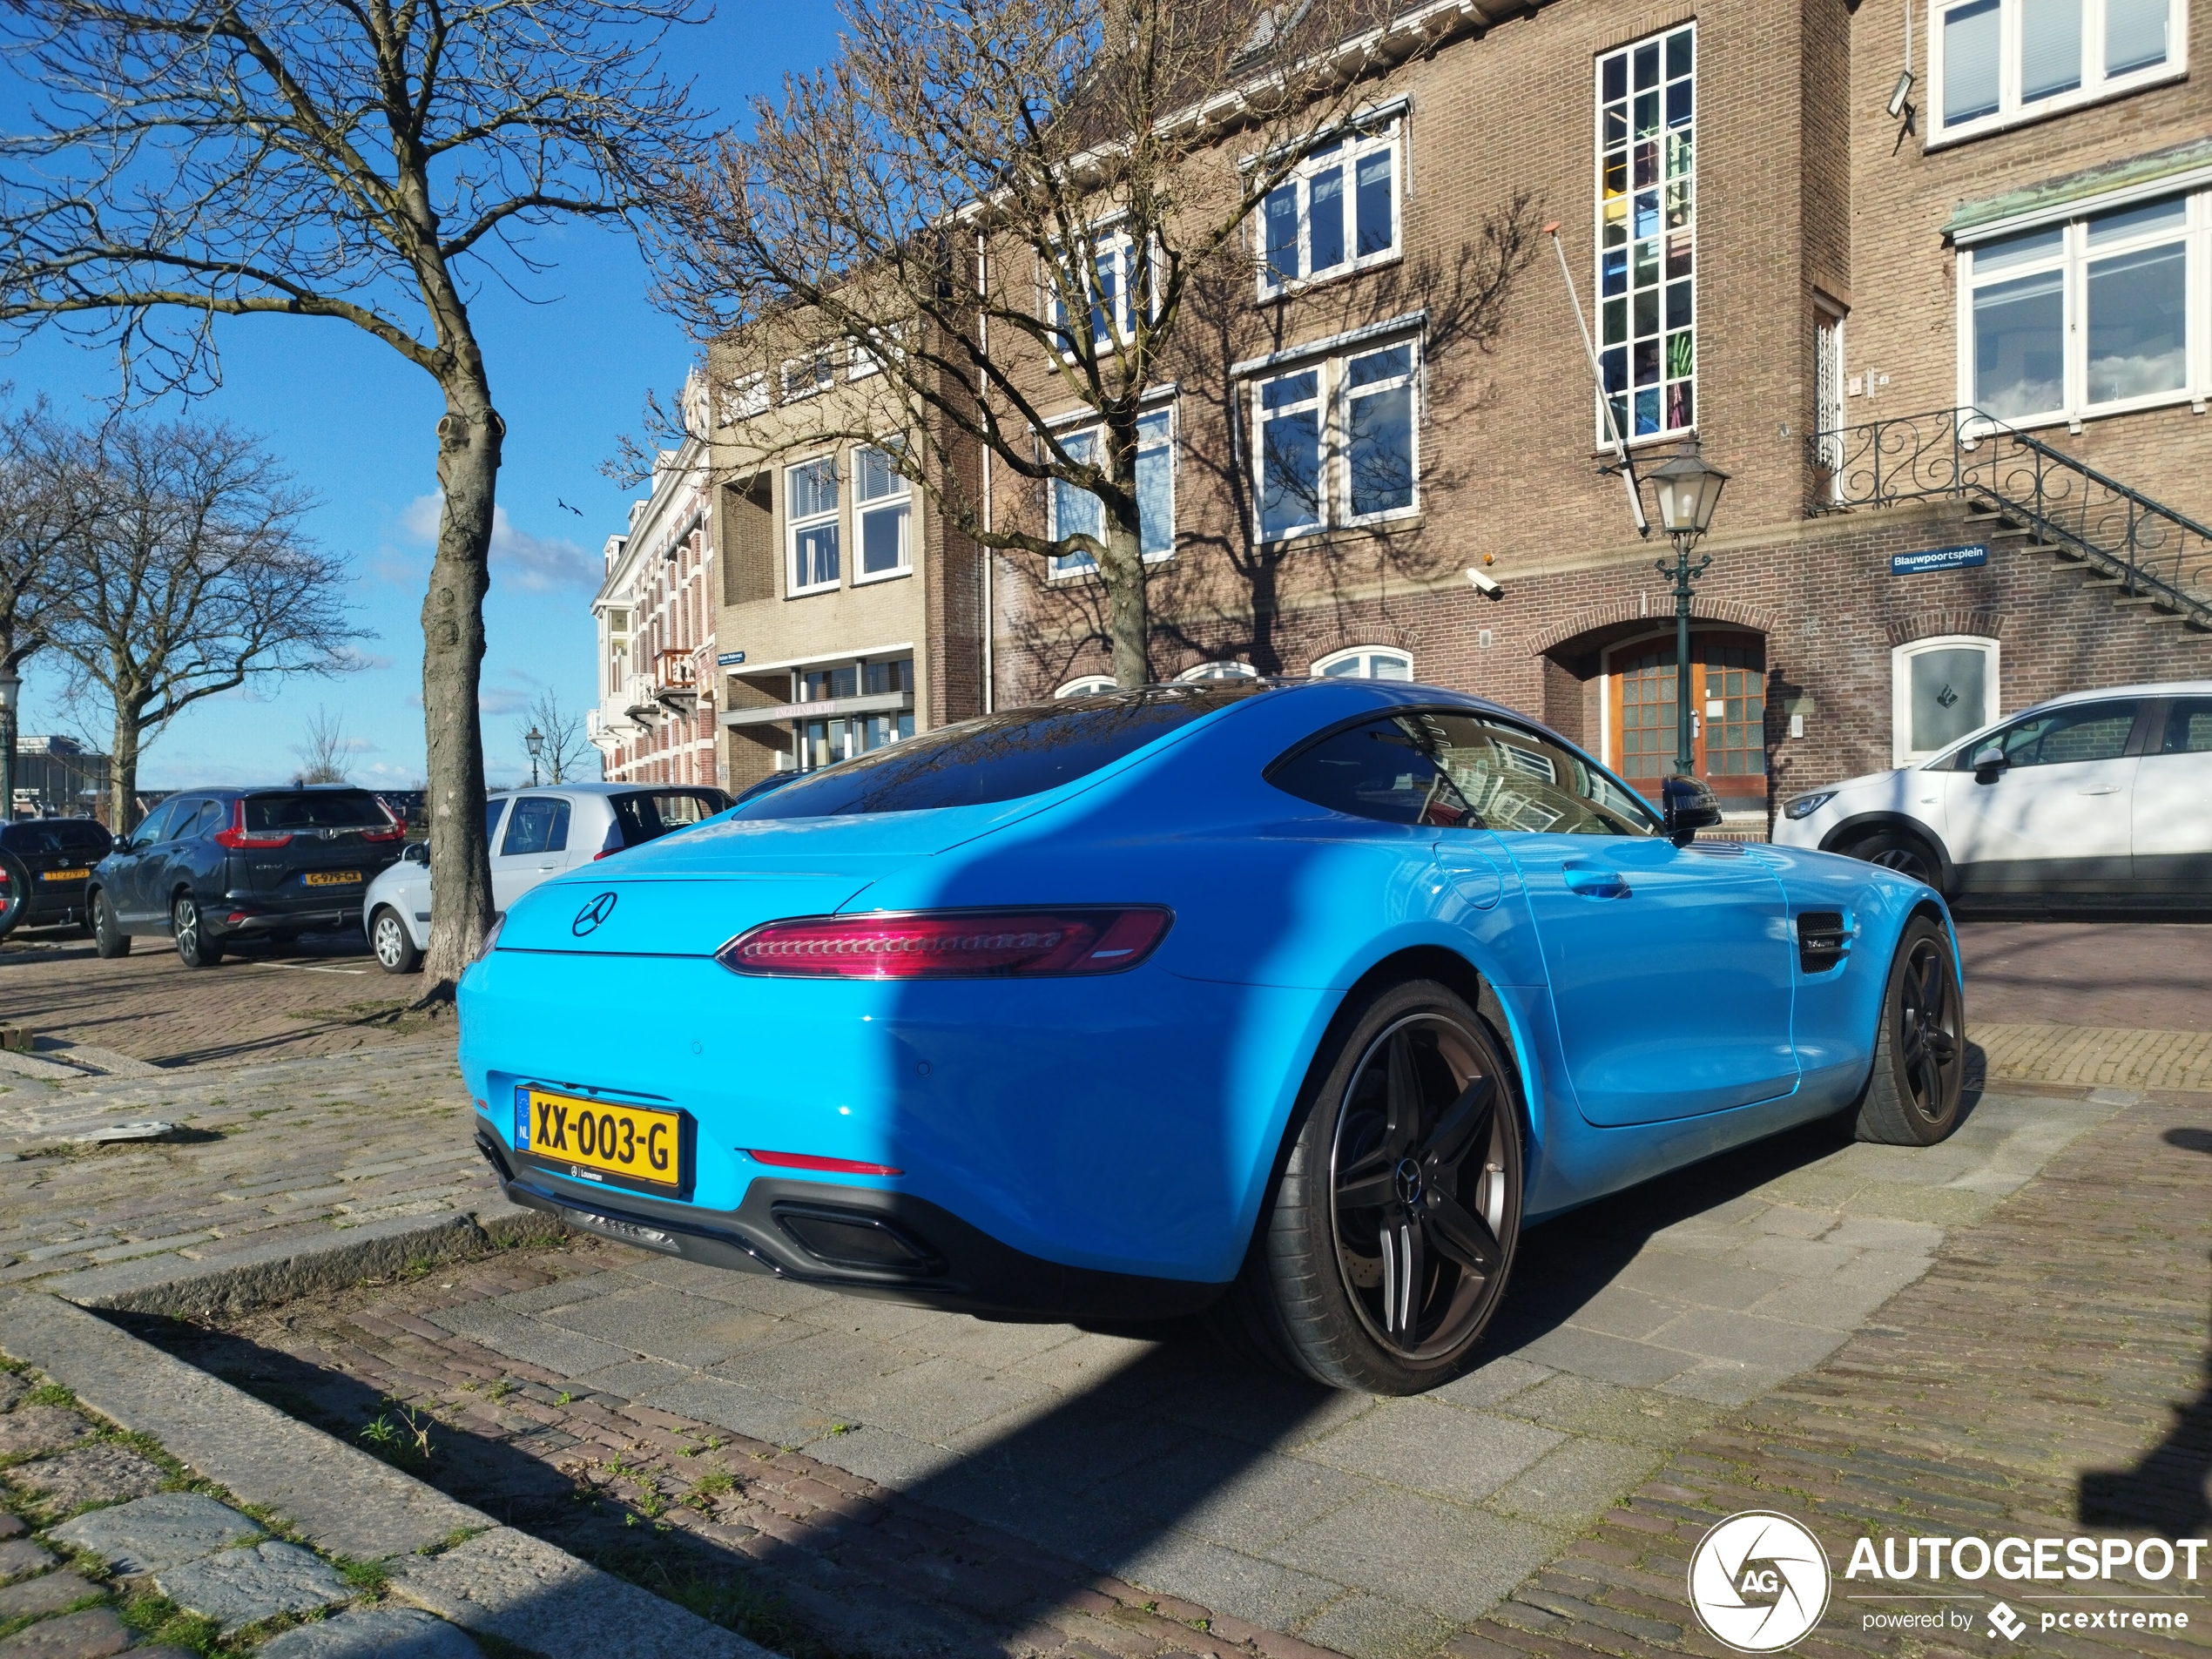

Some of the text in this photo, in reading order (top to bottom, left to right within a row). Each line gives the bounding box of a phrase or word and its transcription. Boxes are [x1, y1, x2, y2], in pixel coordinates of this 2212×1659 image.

[1894, 548, 1984, 566] Blauwpoortsplein
[776, 702, 835, 718] ENGELENBURCHT
[310, 872, 359, 884] G-979-GX
[519, 1125, 529, 1140] NL
[536, 1102, 669, 1171] XX-003-G
[581, 1169, 603, 1182] Louwman
